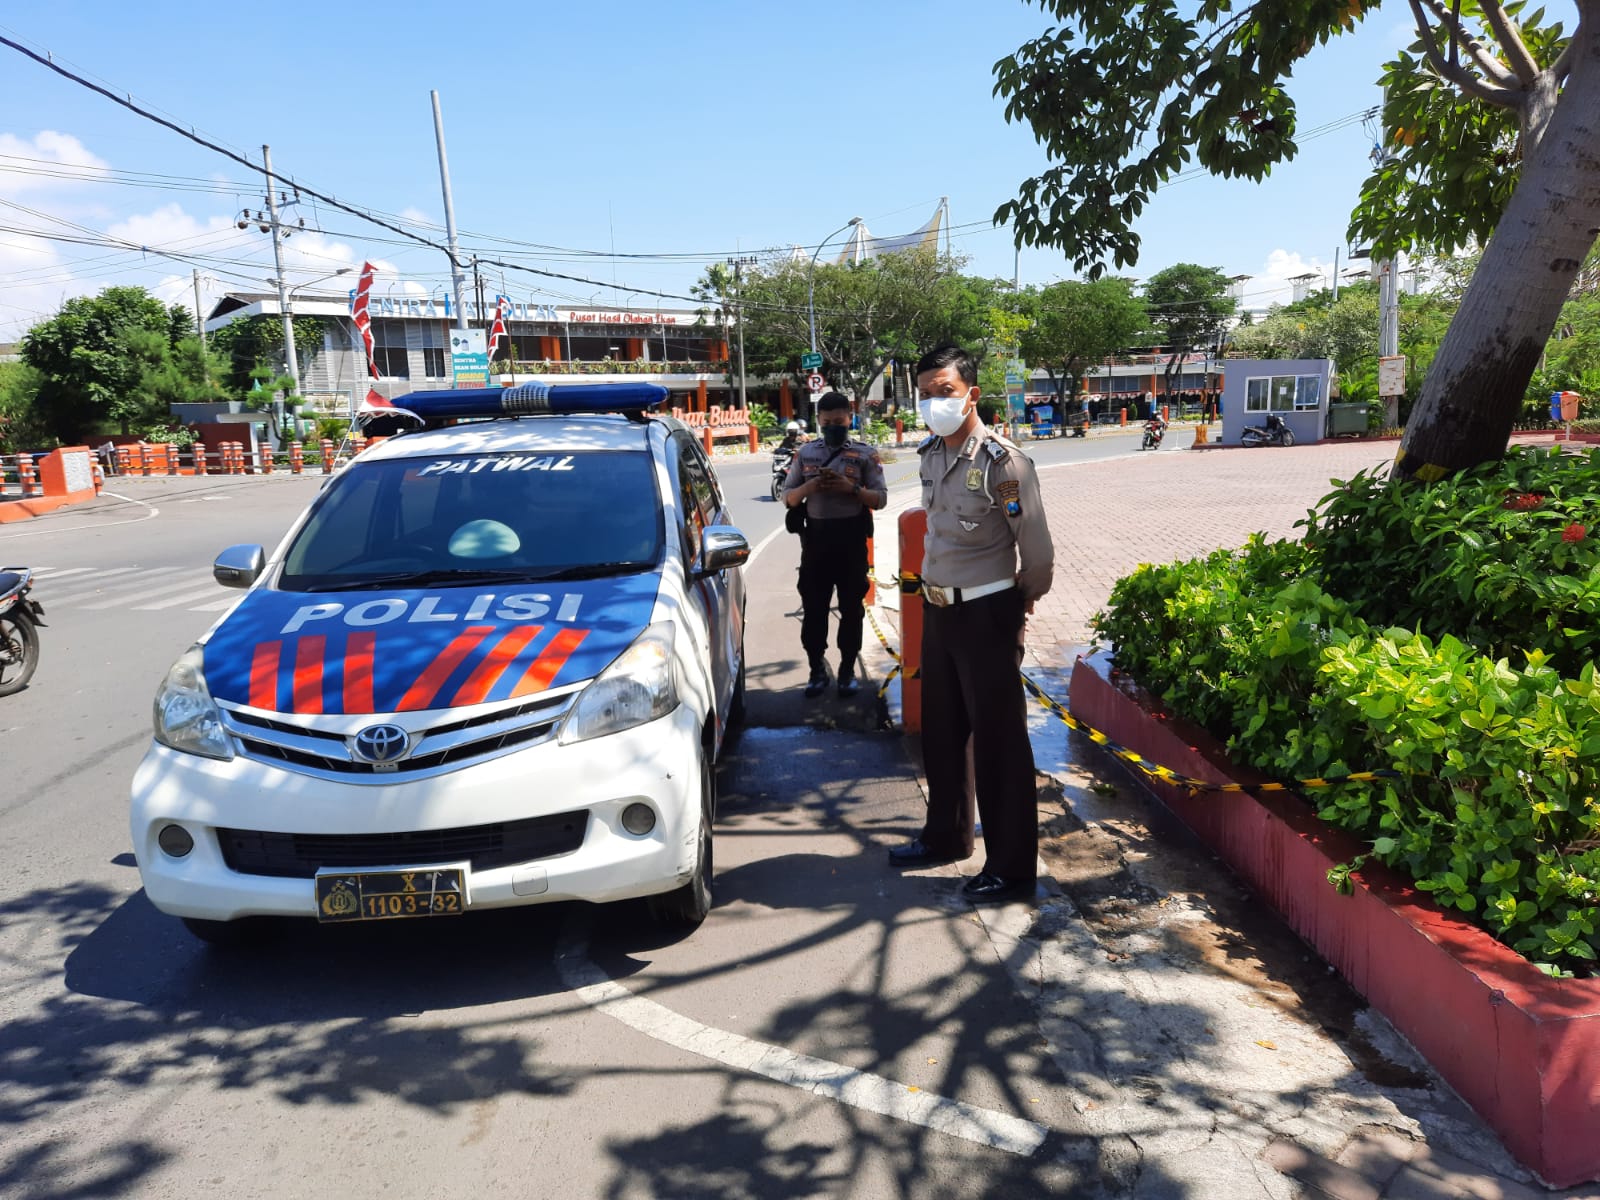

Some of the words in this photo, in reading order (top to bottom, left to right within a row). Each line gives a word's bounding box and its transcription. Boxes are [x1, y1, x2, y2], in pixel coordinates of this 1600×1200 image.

[570, 312, 596, 323] Pusat
[599, 313, 621, 323] Hasil
[624, 313, 653, 324] Olahan
[656, 313, 676, 324] Ikan
[708, 405, 752, 426] Bulak
[416, 456, 575, 477] PATWAL
[279, 594, 584, 634] POLISI
[401, 873, 416, 892] X
[368, 894, 458, 916] 1103-32
